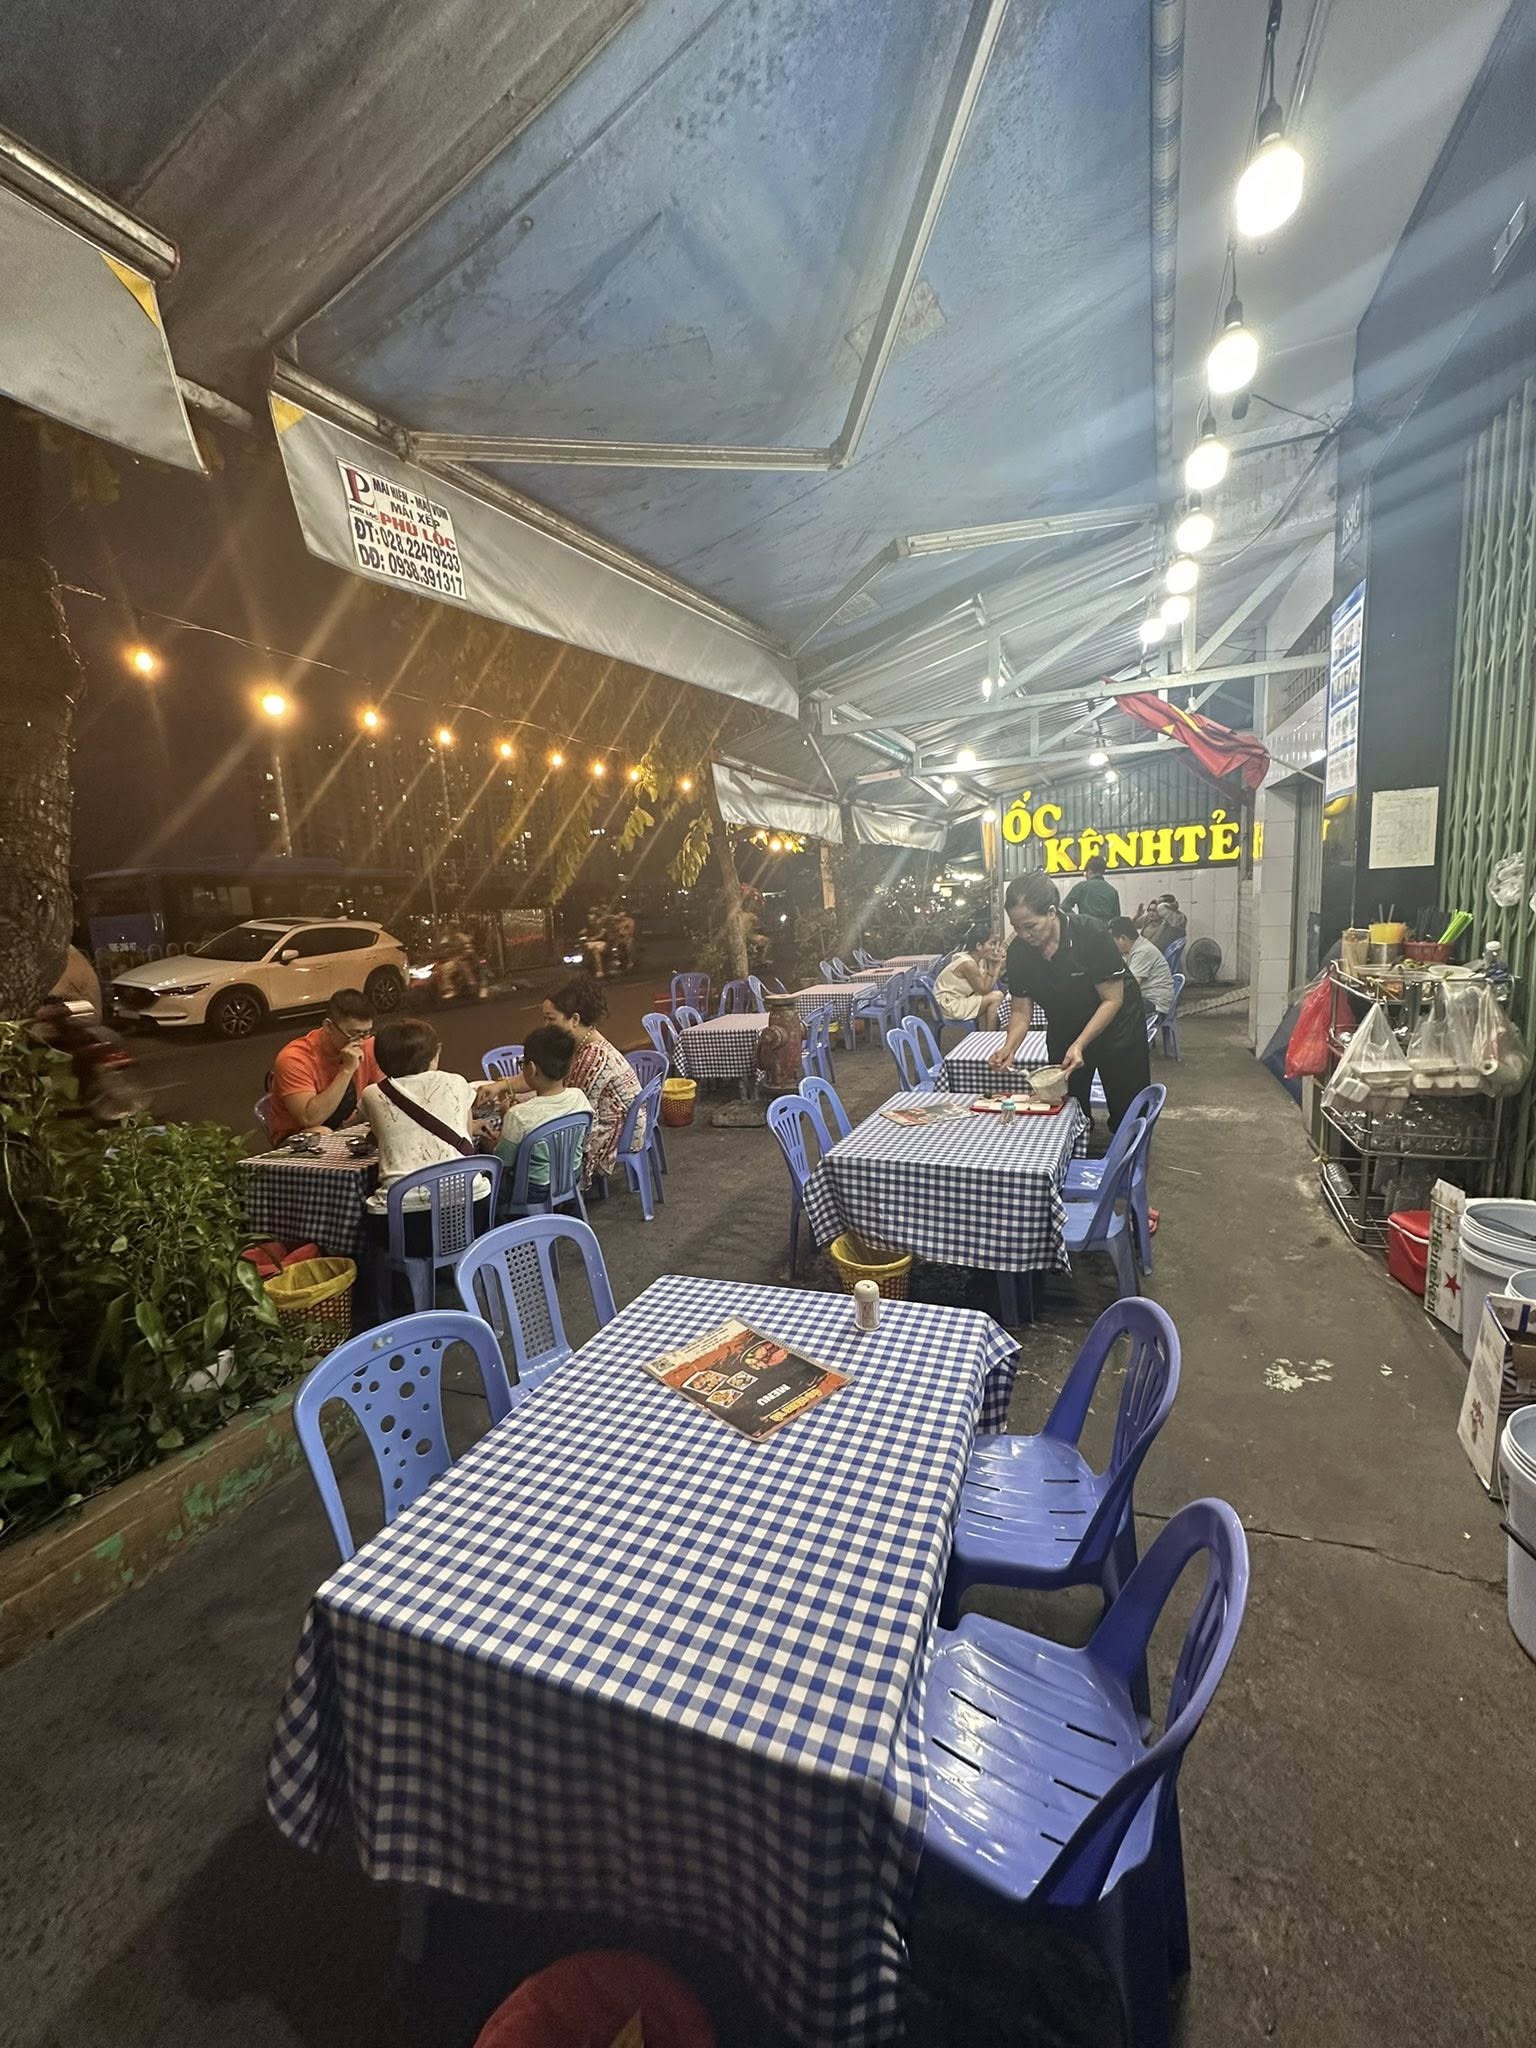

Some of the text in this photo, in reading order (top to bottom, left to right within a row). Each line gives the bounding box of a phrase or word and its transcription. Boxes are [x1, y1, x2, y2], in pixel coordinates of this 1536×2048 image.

[380, 511, 418, 536] PHÚ
[391, 501, 414, 521] MÁI
[388, 552, 462, 596] 0938.391317
[1002, 790, 1063, 843] ỐC
[1426, 1230, 1442, 1312] Heineken
[757, 1384, 791, 1406] MENU
